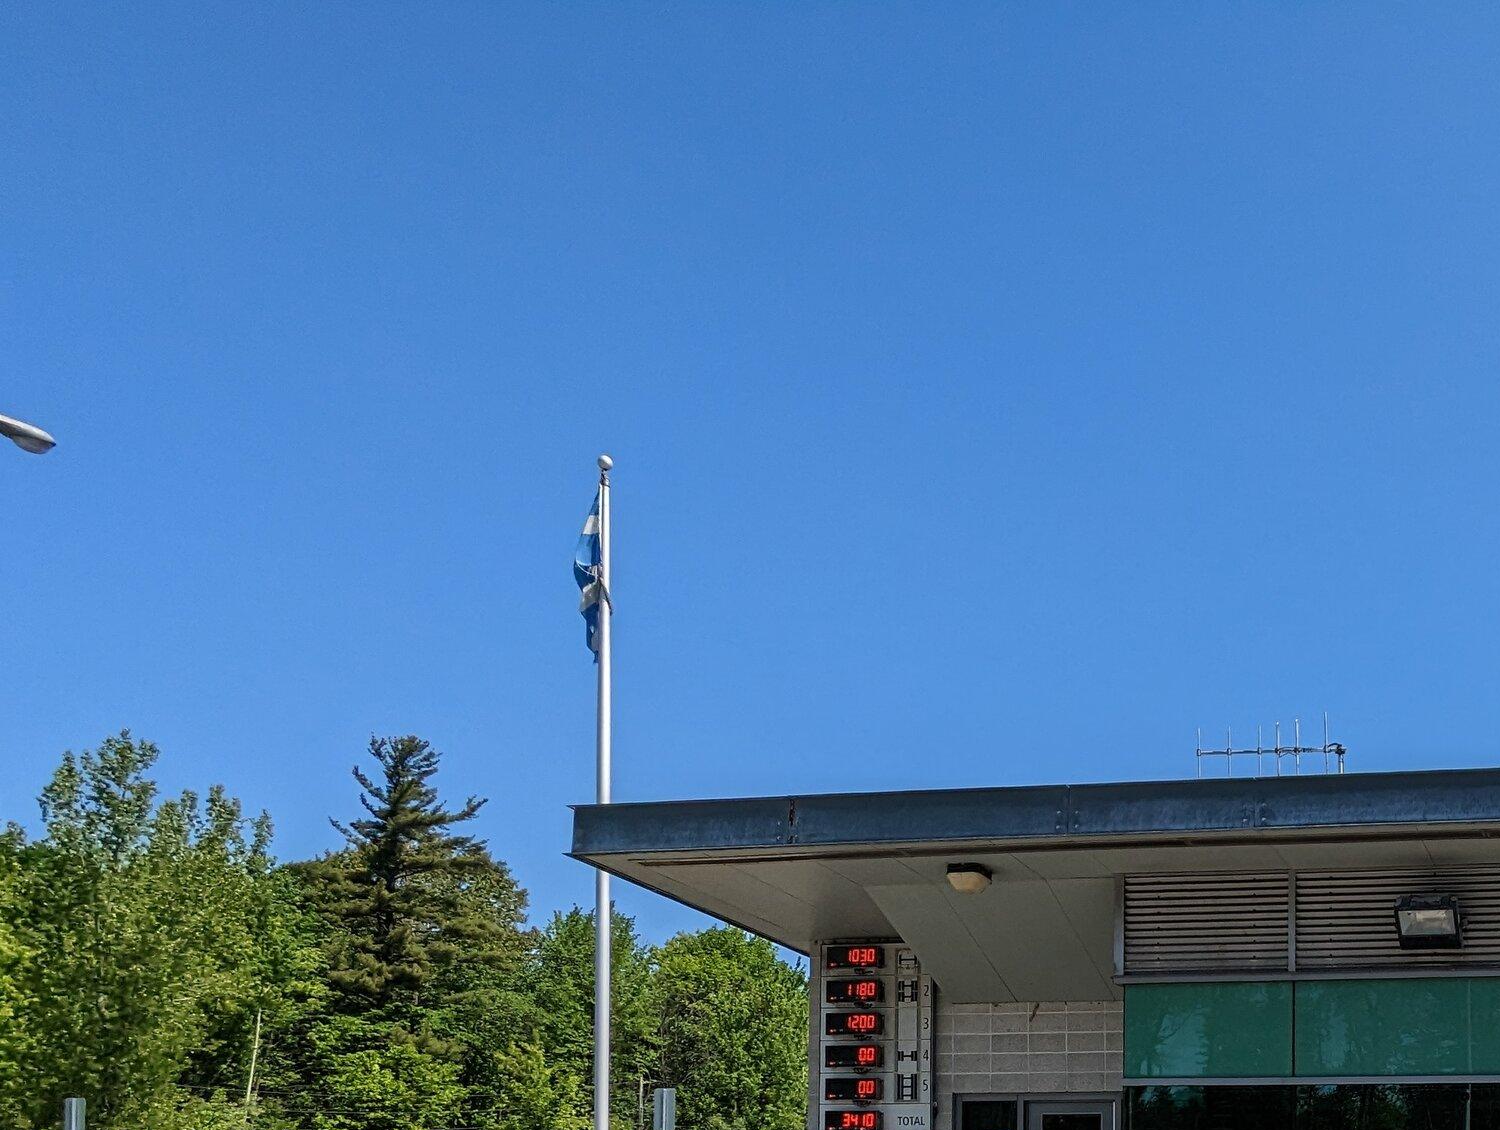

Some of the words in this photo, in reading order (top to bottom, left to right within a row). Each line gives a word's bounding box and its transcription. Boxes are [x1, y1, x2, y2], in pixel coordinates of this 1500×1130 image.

[848, 948, 875, 962] 1030
[848, 982, 875, 996] 1180
[923, 984, 930, 997] 2
[847, 1015, 875, 1029] 1200
[923, 1017, 930, 1030] 3
[858, 1047, 875, 1061] 00
[922, 1049, 930, 1061] 4
[858, 1080, 875, 1094] 00
[922, 1079, 929, 1092] 5
[842, 1113, 875, 1127] 3410
[897, 1116, 925, 1126] TOTAL
